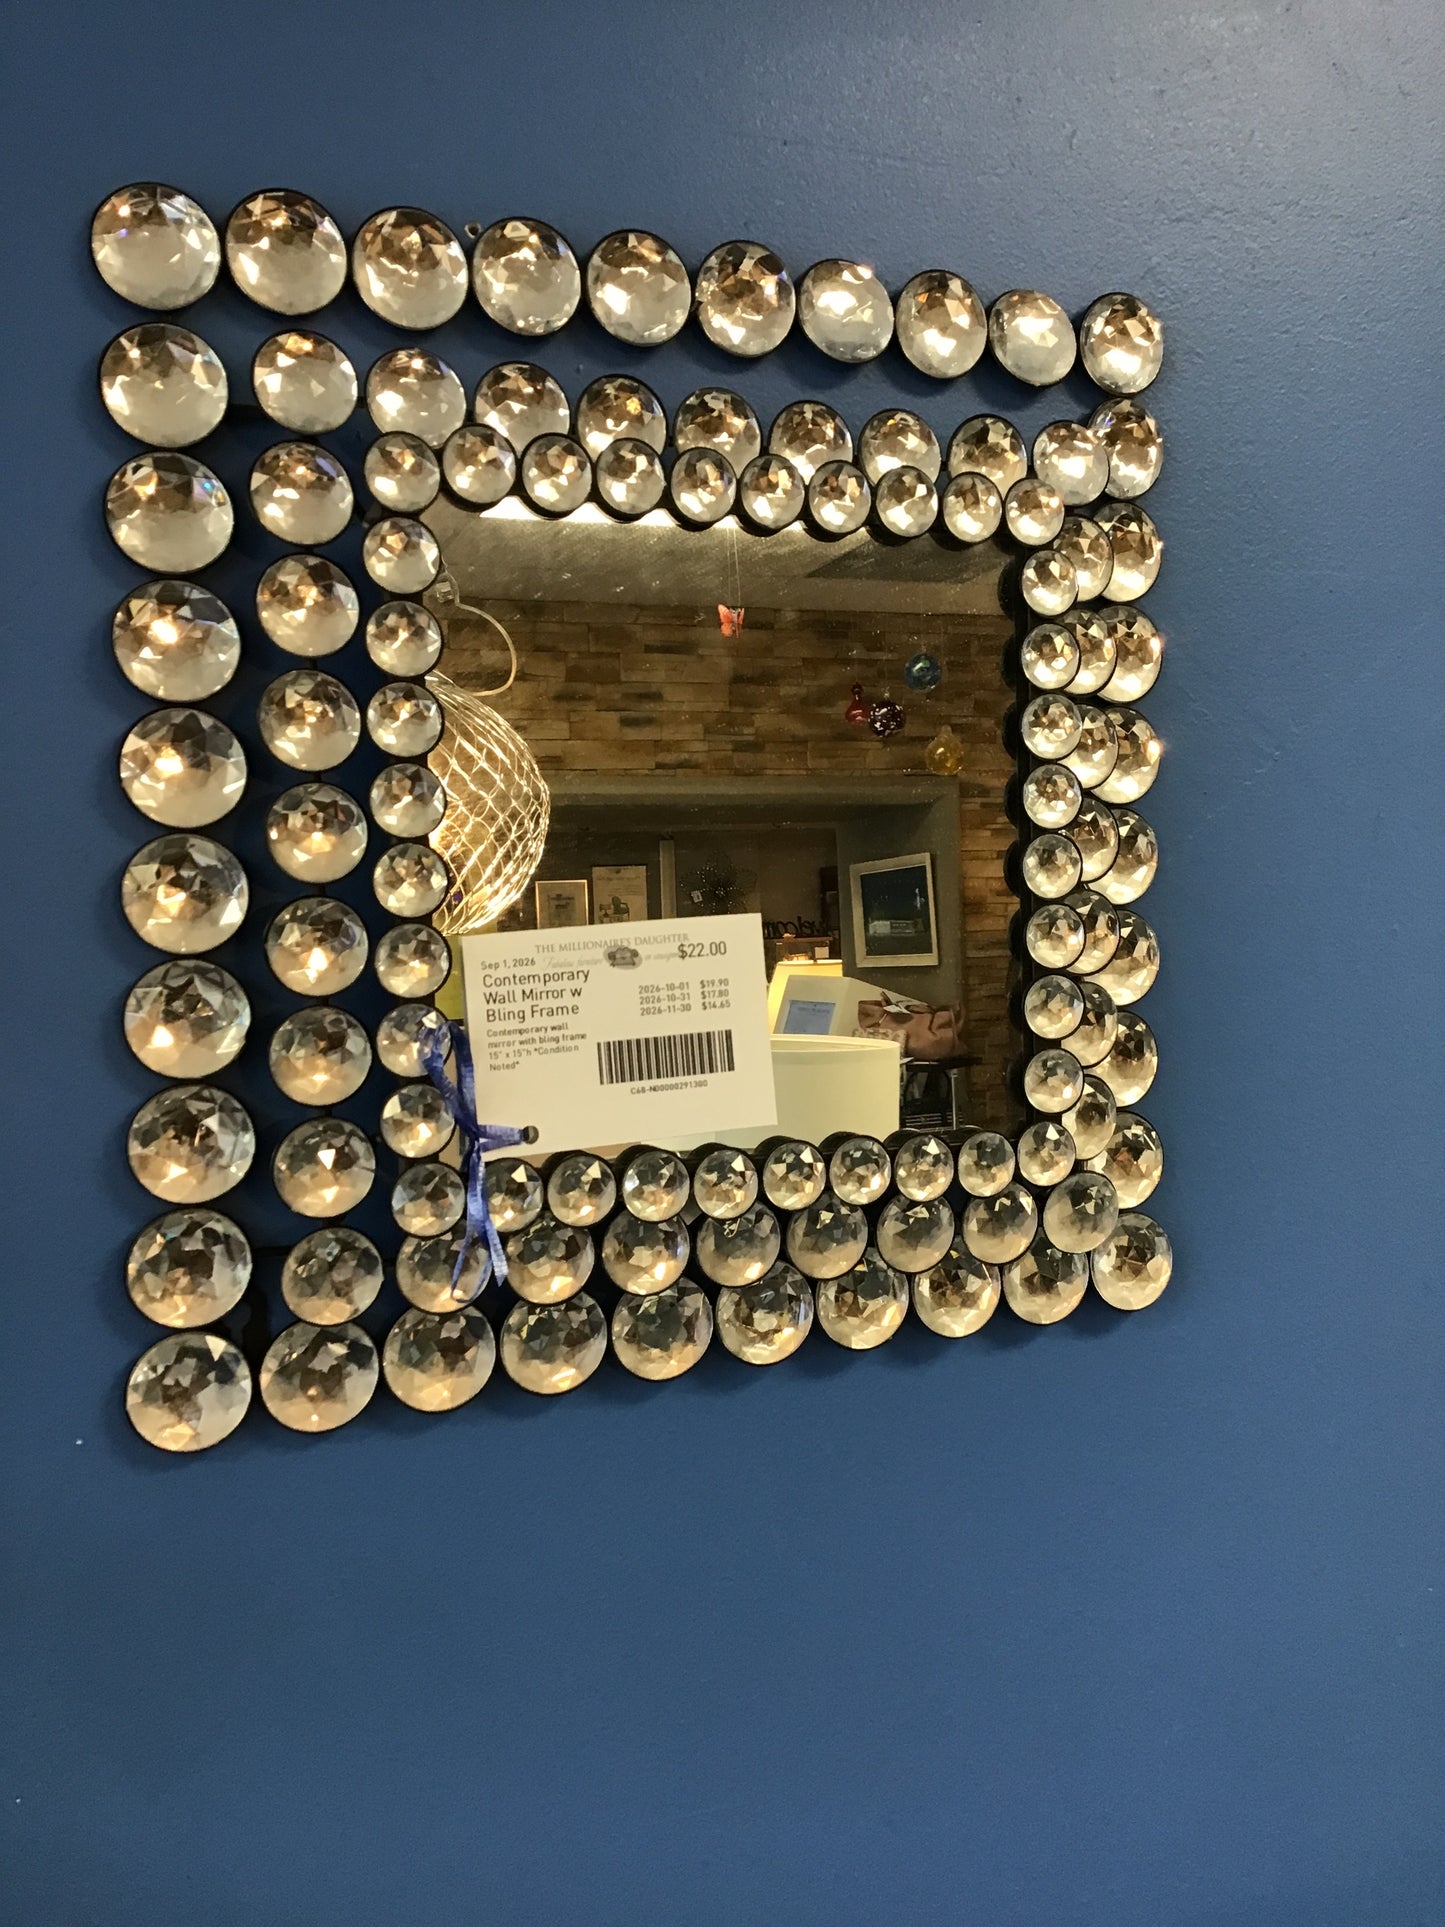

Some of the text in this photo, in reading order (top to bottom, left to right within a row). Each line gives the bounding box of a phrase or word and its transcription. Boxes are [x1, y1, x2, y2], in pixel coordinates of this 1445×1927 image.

[535, 933, 690, 954] THE MILLIONAIRE'S DAUGHTER
[677, 941, 727, 960] $22.00
[480, 960, 500, 971] Sep
[503, 958, 511, 969] 1,
[512, 957, 536, 968] 2026
[482, 969, 590, 988] Contemporary
[638, 978, 729, 994] 2026-10-01 $19.90
[483, 986, 583, 1005] Wall Mirror w
[639, 992, 691, 1005] 2026-10-31
[486, 1003, 580, 1024] Bling Frame
[640, 1003, 692, 1016] 2026-11-30
[487, 1022, 569, 1038] Contemporary wall
[487, 1032, 587, 1049] mirror with bling frame
